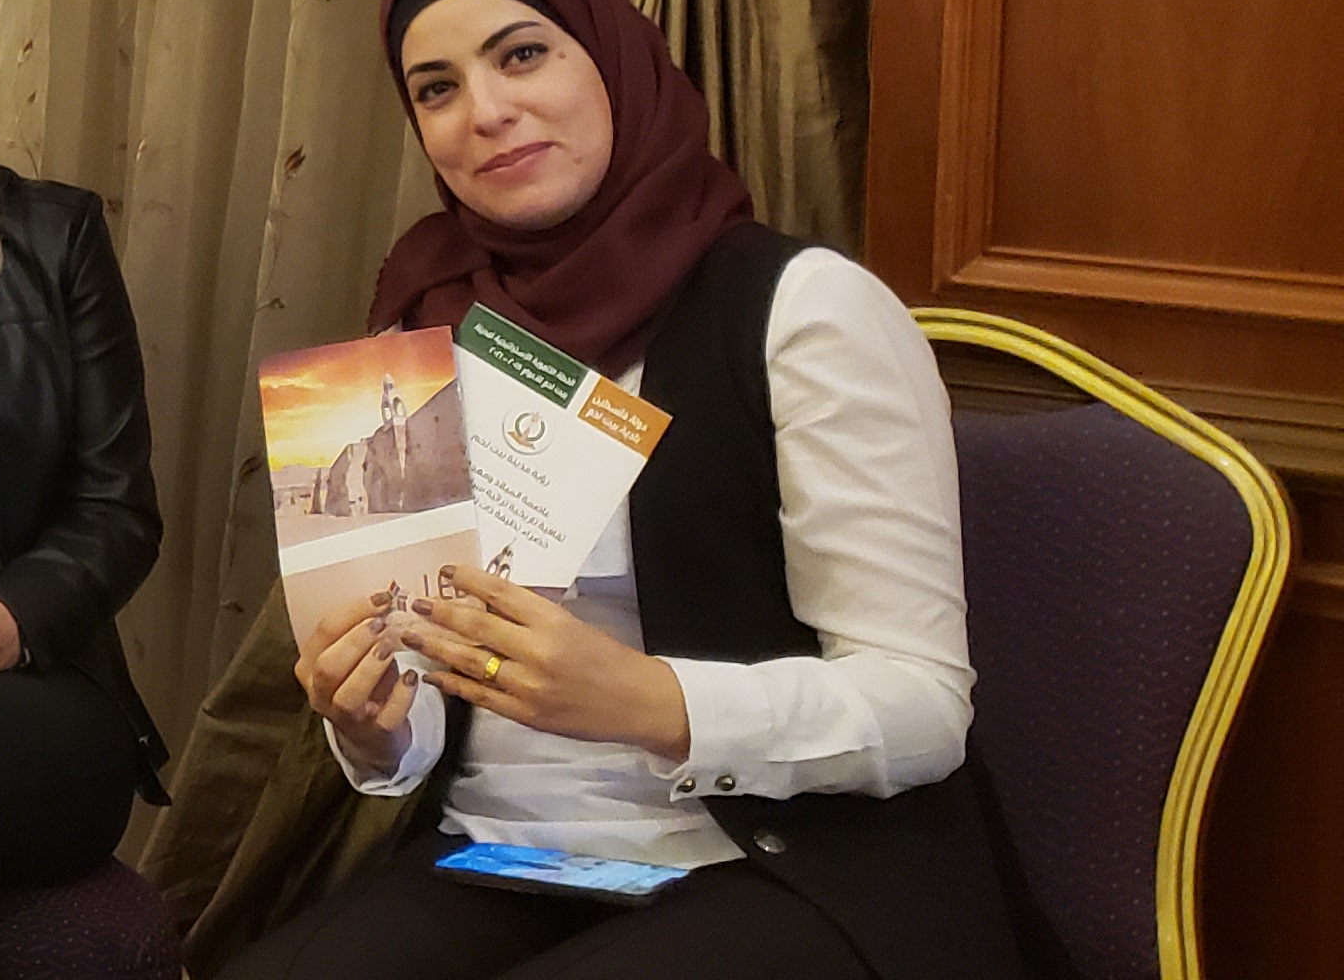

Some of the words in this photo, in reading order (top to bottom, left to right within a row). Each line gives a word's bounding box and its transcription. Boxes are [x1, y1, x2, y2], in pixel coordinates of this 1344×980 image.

[592, 395, 629, 420] فلسطين
[471, 434, 491, 448] لحم
[489, 445, 507, 459] بيت
[507, 454, 531, 474] مدينة
